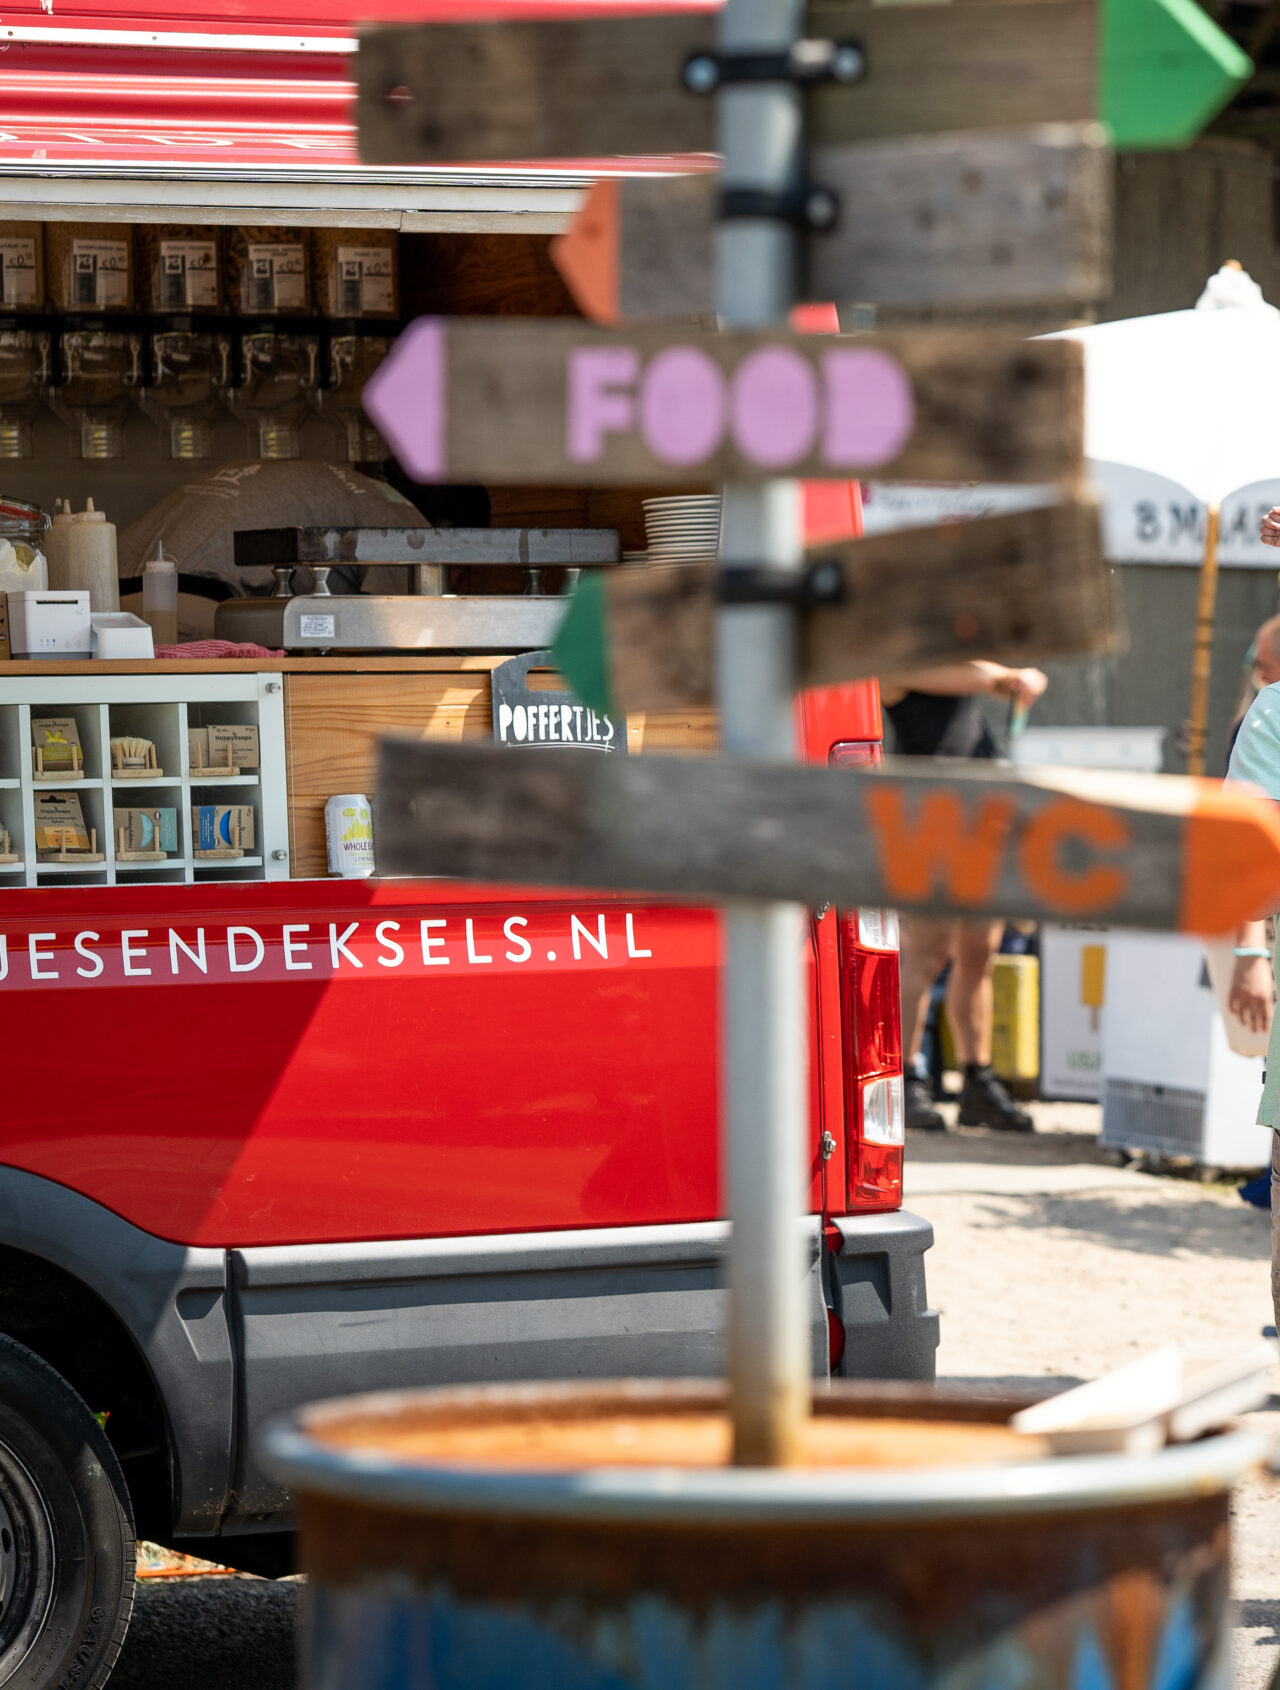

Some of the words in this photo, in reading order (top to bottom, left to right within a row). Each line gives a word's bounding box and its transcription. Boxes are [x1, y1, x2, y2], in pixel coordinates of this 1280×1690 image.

[567, 345, 914, 468] FOOD
[499, 704, 615, 741] POFFERTJES
[343, 842, 367, 851] WHOLE
[866, 783, 1133, 914] WC
